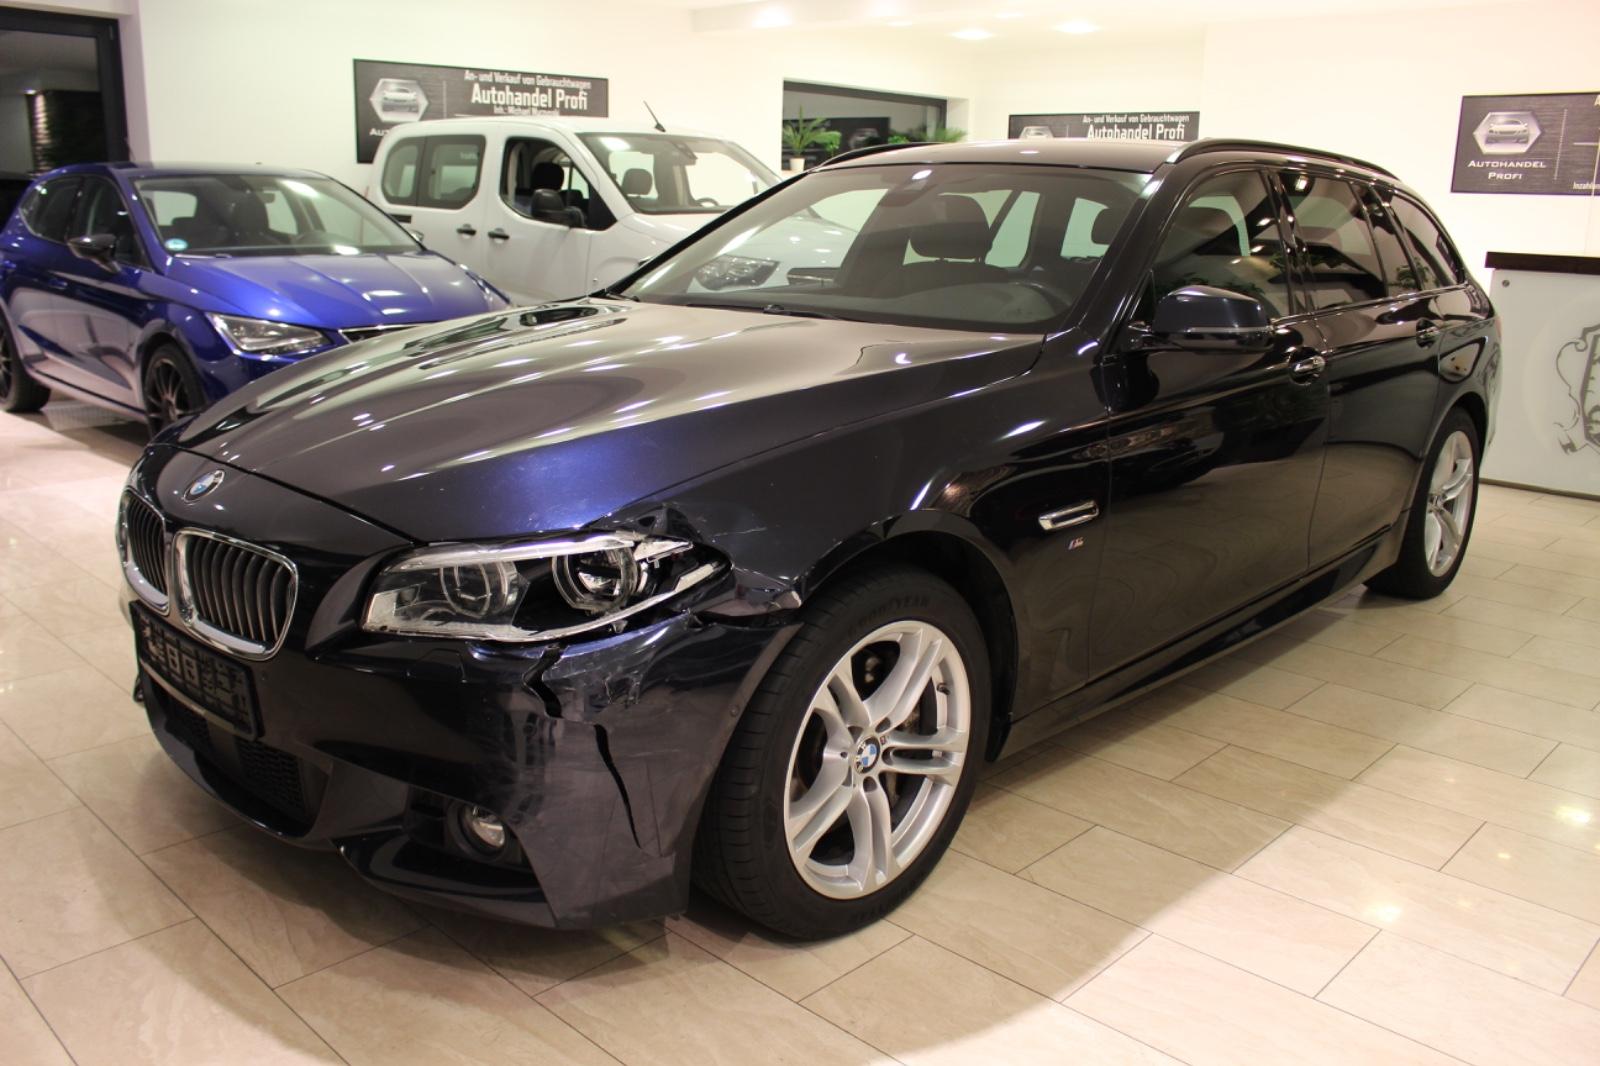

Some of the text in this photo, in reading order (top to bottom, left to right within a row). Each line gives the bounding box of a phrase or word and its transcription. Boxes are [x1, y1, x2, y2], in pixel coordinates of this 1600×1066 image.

[478, 72, 493, 83] und
[493, 72, 521, 84] Verkauf
[522, 77, 535, 86] von
[536, 75, 592, 90] Gebrauchtwagen
[471, 82, 588, 111] Autohandel Profi
[1094, 115, 1105, 123] und
[1105, 114, 1127, 123] Verkauf
[1128, 115, 1139, 123] von
[1140, 113, 1190, 124] Gebrauchtwagen
[1087, 123, 1185, 140] Autohandel Profi
[1467, 160, 1547, 168] AUTOHANDEL
[1488, 172, 1523, 180] PROFI
